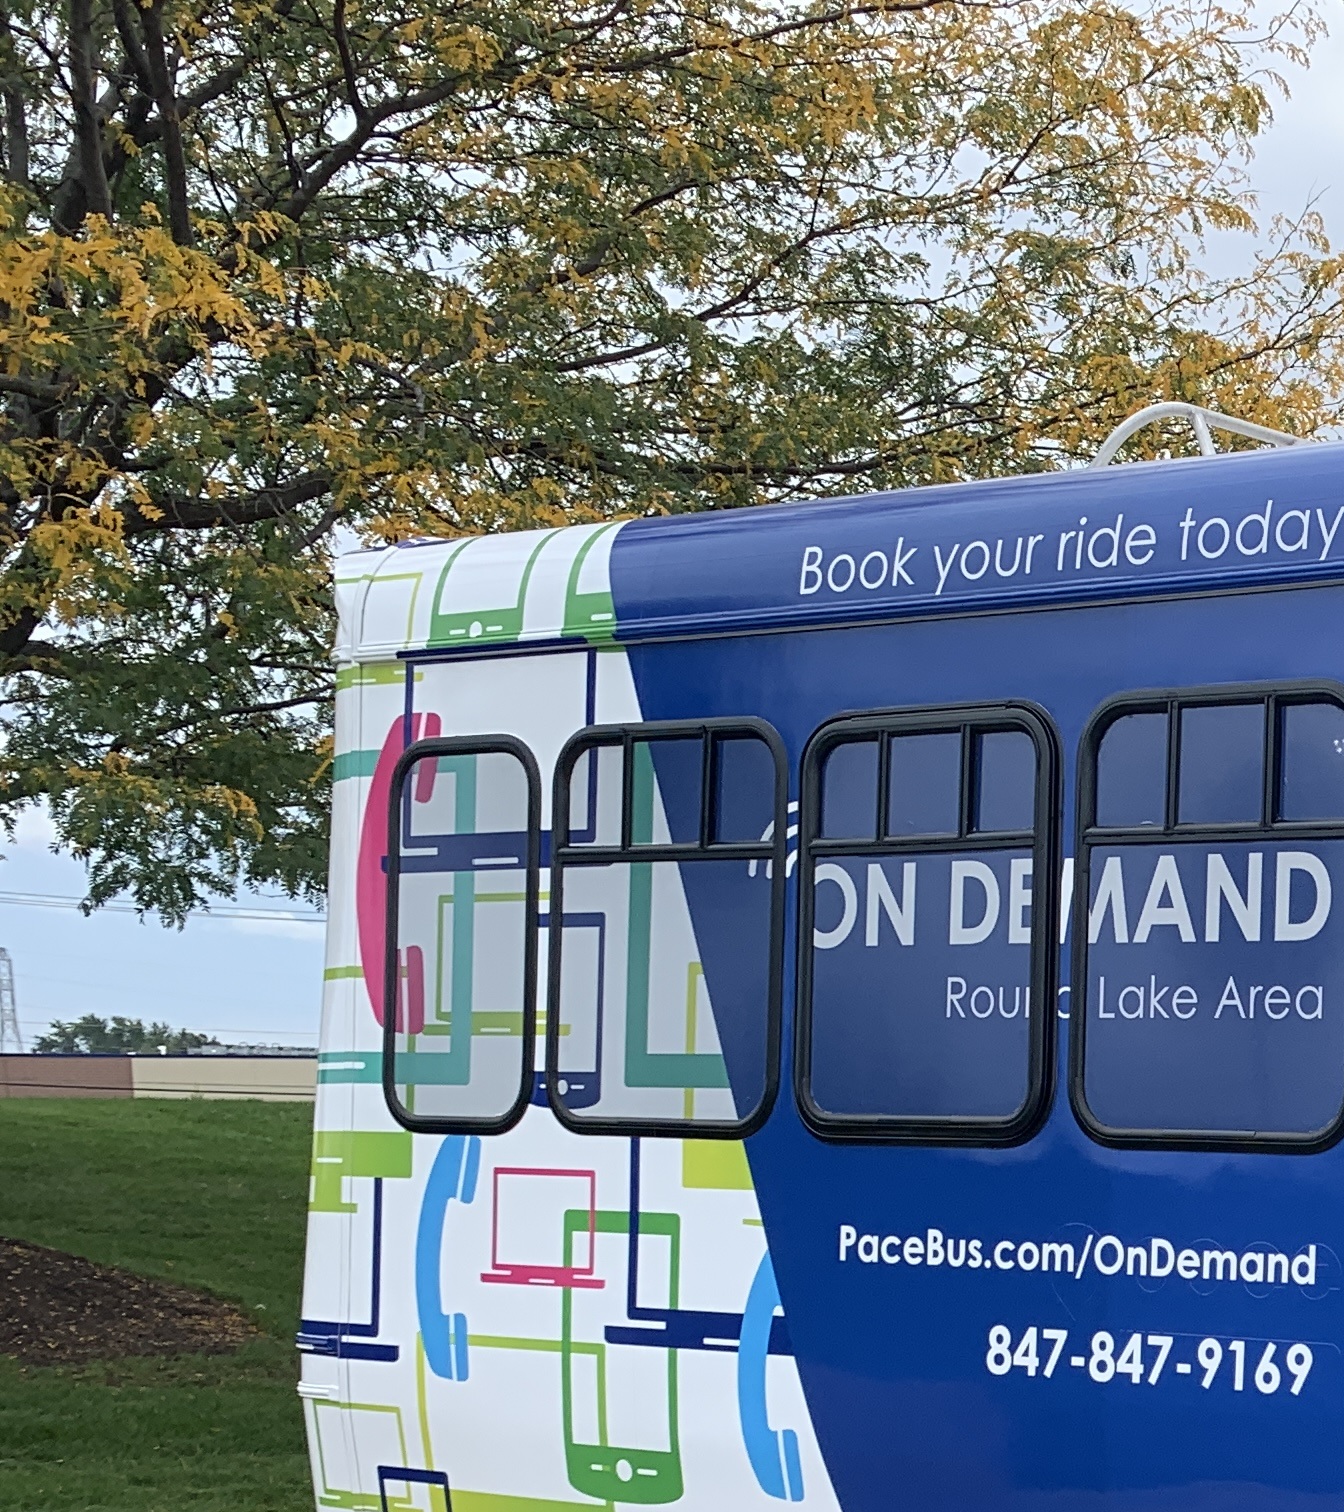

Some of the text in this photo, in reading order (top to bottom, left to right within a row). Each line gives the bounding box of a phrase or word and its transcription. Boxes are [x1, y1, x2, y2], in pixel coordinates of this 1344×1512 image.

[799, 536, 918, 596] Book
[933, 535, 1043, 596] your
[1057, 513, 1157, 573] ride
[813, 851, 1334, 950] ON DEMAND
[1098, 973, 1200, 1020] Lake
[1214, 974, 1324, 1020] Area
[838, 1223, 1317, 1286] PaceBus.com/OnDemand
[985, 1324, 1315, 1397] 847-847-9169
